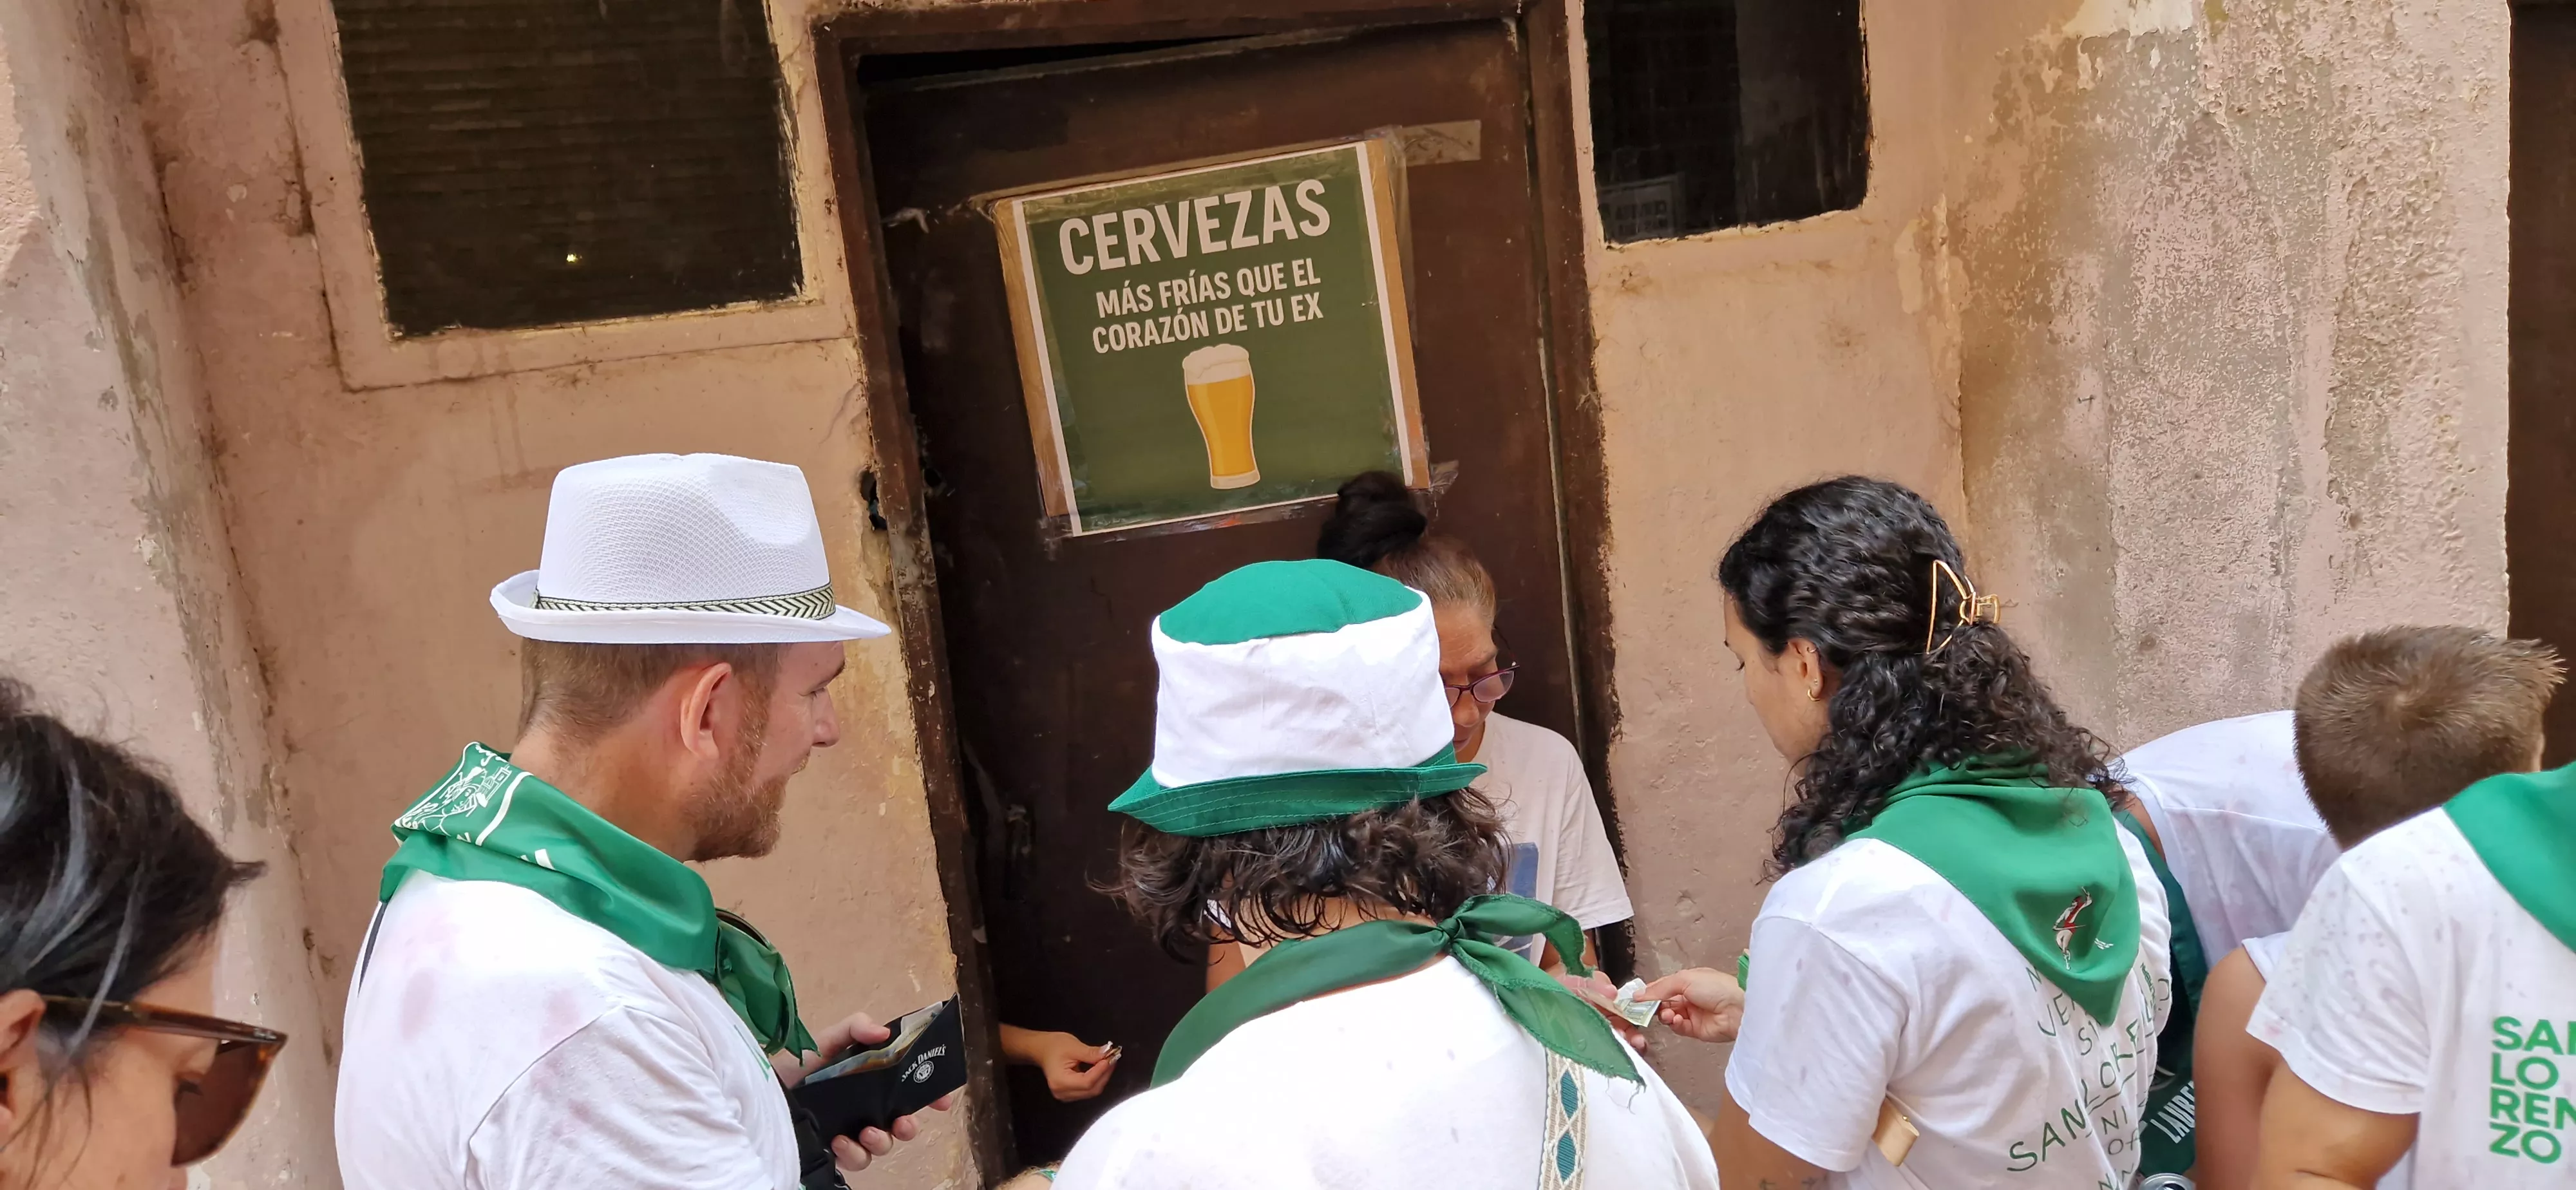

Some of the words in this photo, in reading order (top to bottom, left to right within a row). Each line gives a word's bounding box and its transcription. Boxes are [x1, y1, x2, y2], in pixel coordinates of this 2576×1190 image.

[1059, 179, 1331, 275] CERVEZAS
[1096, 280, 1153, 317] MÁS
[1159, 270, 1231, 308] FRÍAS
[1237, 262, 1287, 298] QUE
[1293, 258, 1321, 287] EL
[1093, 307, 1209, 354] CORAZÓN
[1215, 305, 1247, 335] DE
[1251, 299, 1284, 328] TU
[1291, 292, 1324, 323] EX
[2492, 1016, 2576, 1055] SA
[2492, 1053, 2559, 1090] LO
[2007, 1099, 2087, 1172] SAN
[2150, 1081, 2195, 1144] LAURE
[2490, 1122, 2562, 1164] ZO
